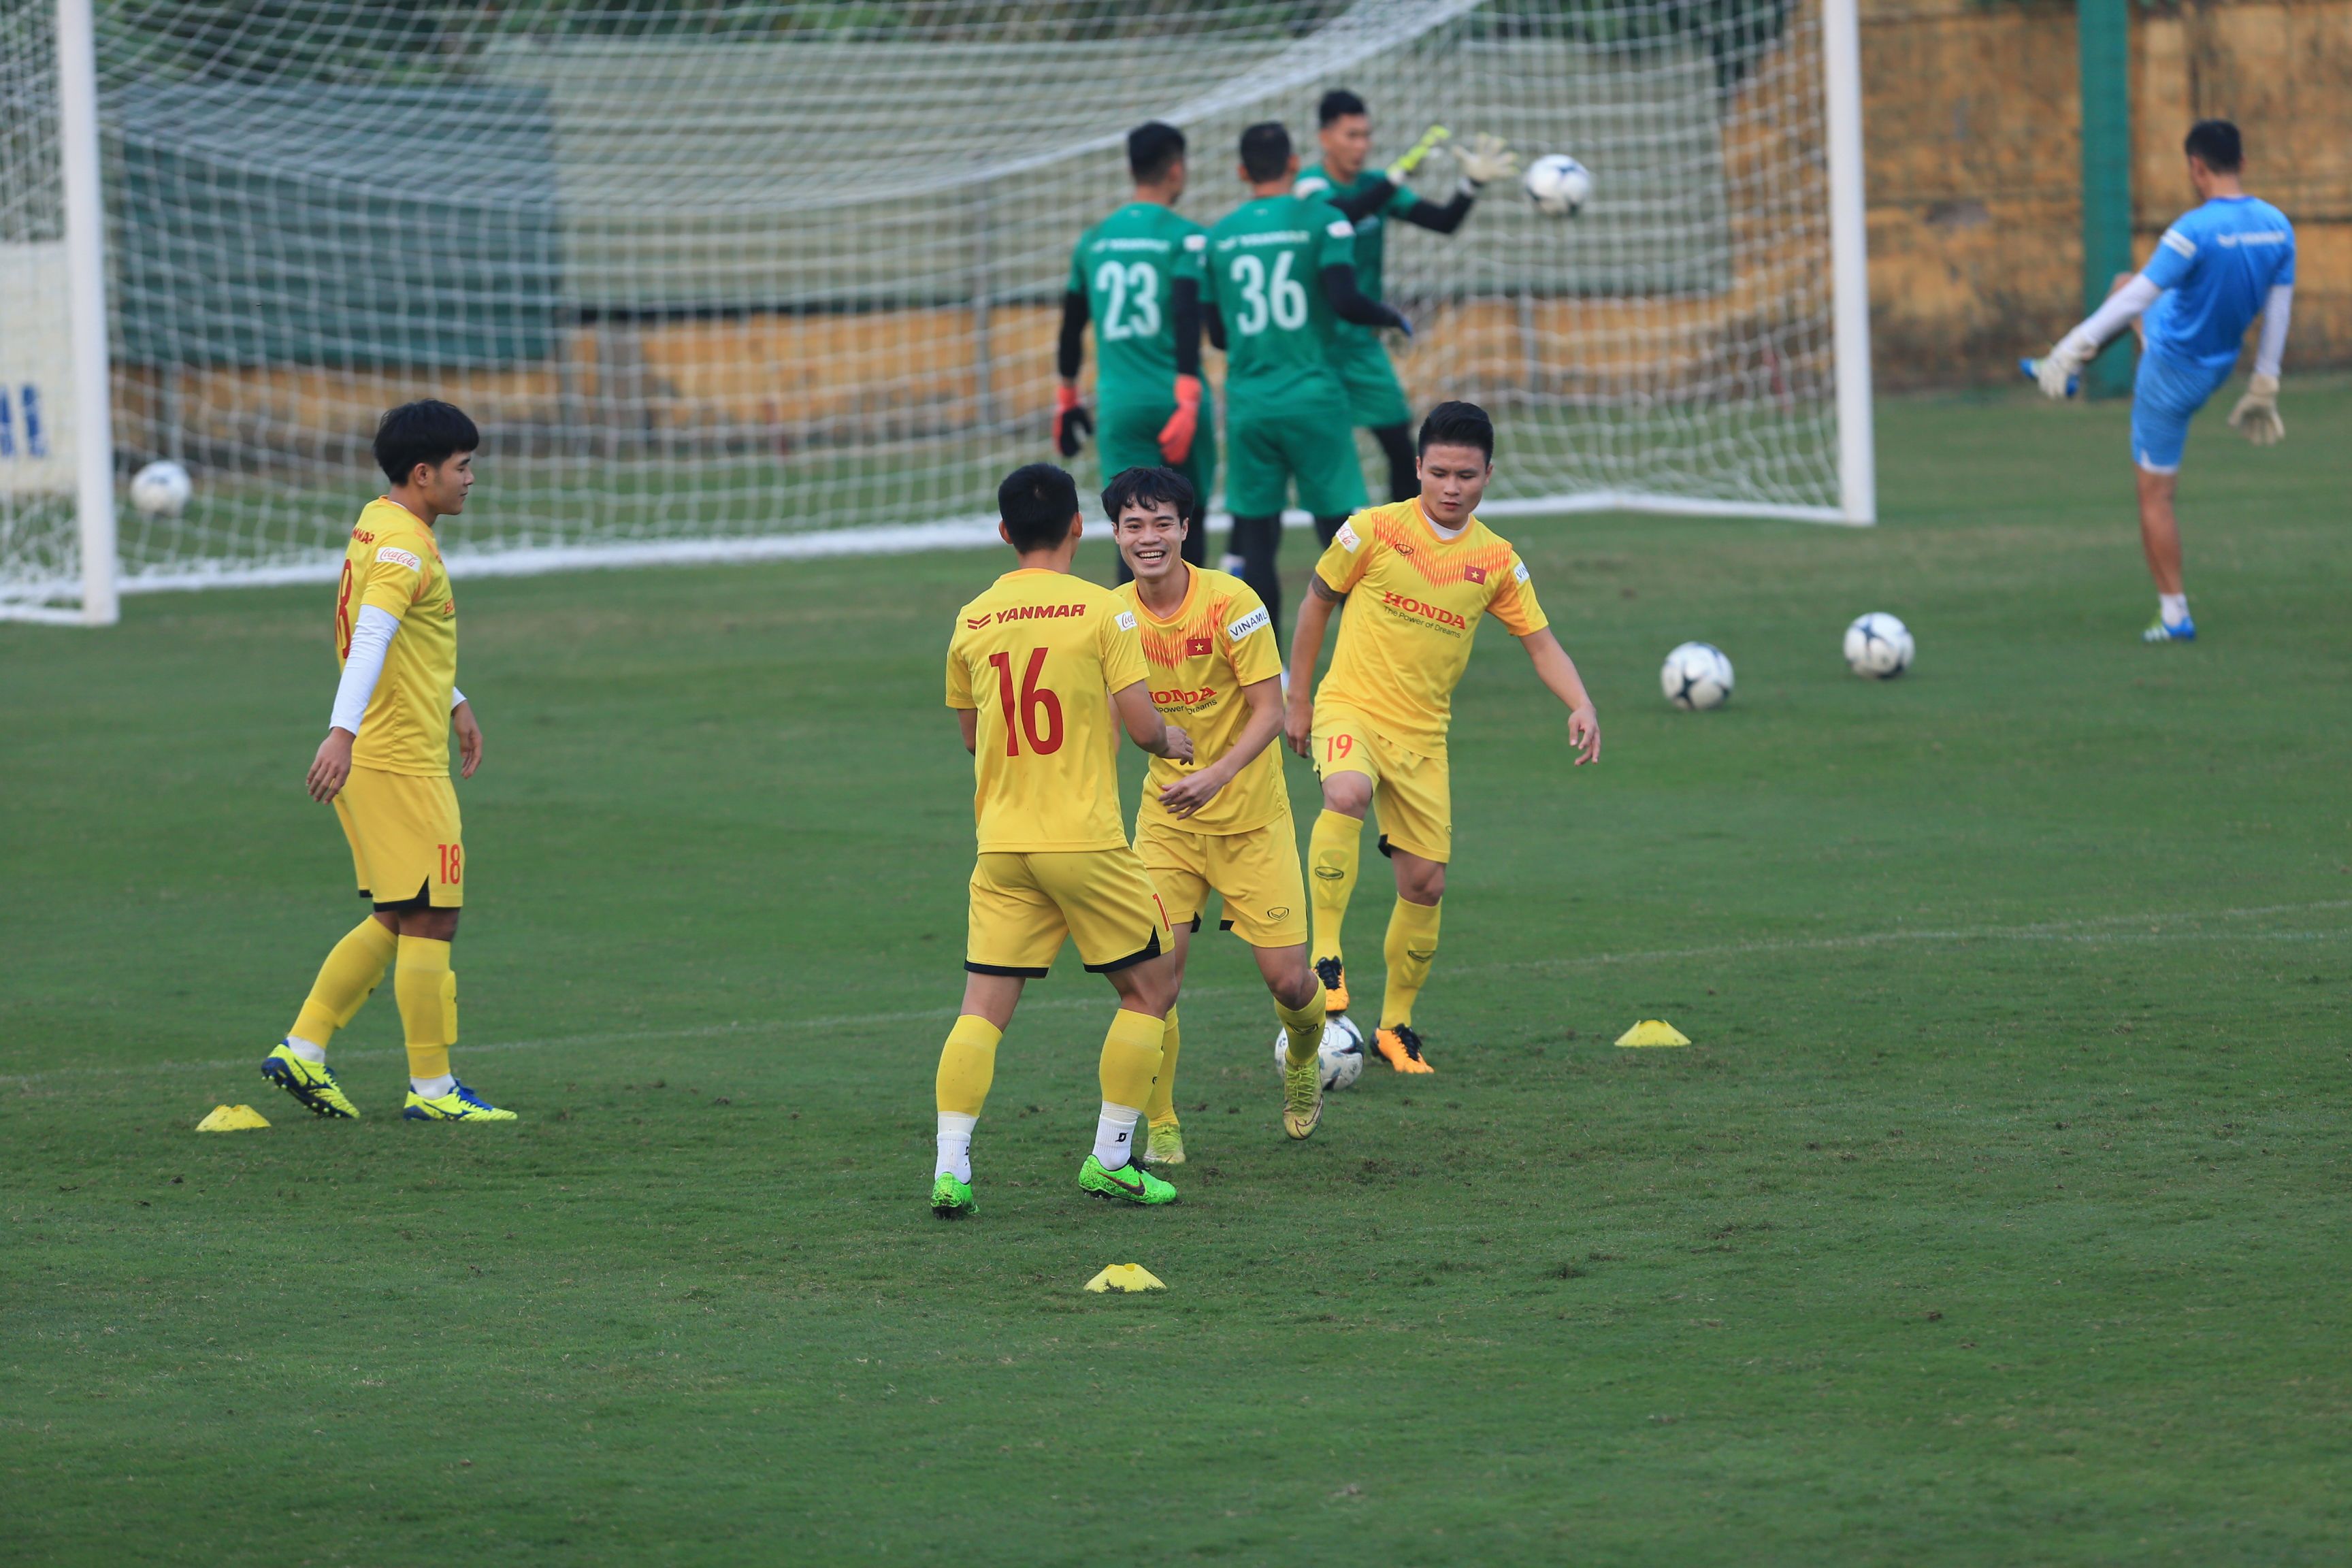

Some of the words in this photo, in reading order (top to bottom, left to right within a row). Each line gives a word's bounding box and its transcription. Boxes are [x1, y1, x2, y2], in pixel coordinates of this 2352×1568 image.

[1096, 260, 1161, 340] 23
[1230, 250, 1308, 336] 36
[336, 559, 352, 659] 8
[996, 604, 1086, 624] YANMAR
[1382, 590, 1466, 630] HONDA
[1384, 605, 1398, 617] The
[1399, 611, 1425, 625] Power
[1435, 624, 1462, 638] Dreams
[989, 647, 1064, 757] 16
[1158, 706, 1184, 714] Power
[1186, 699, 1218, 715] Dreams
[1326, 733, 1353, 762] 19
[438, 843, 461, 885] 18
